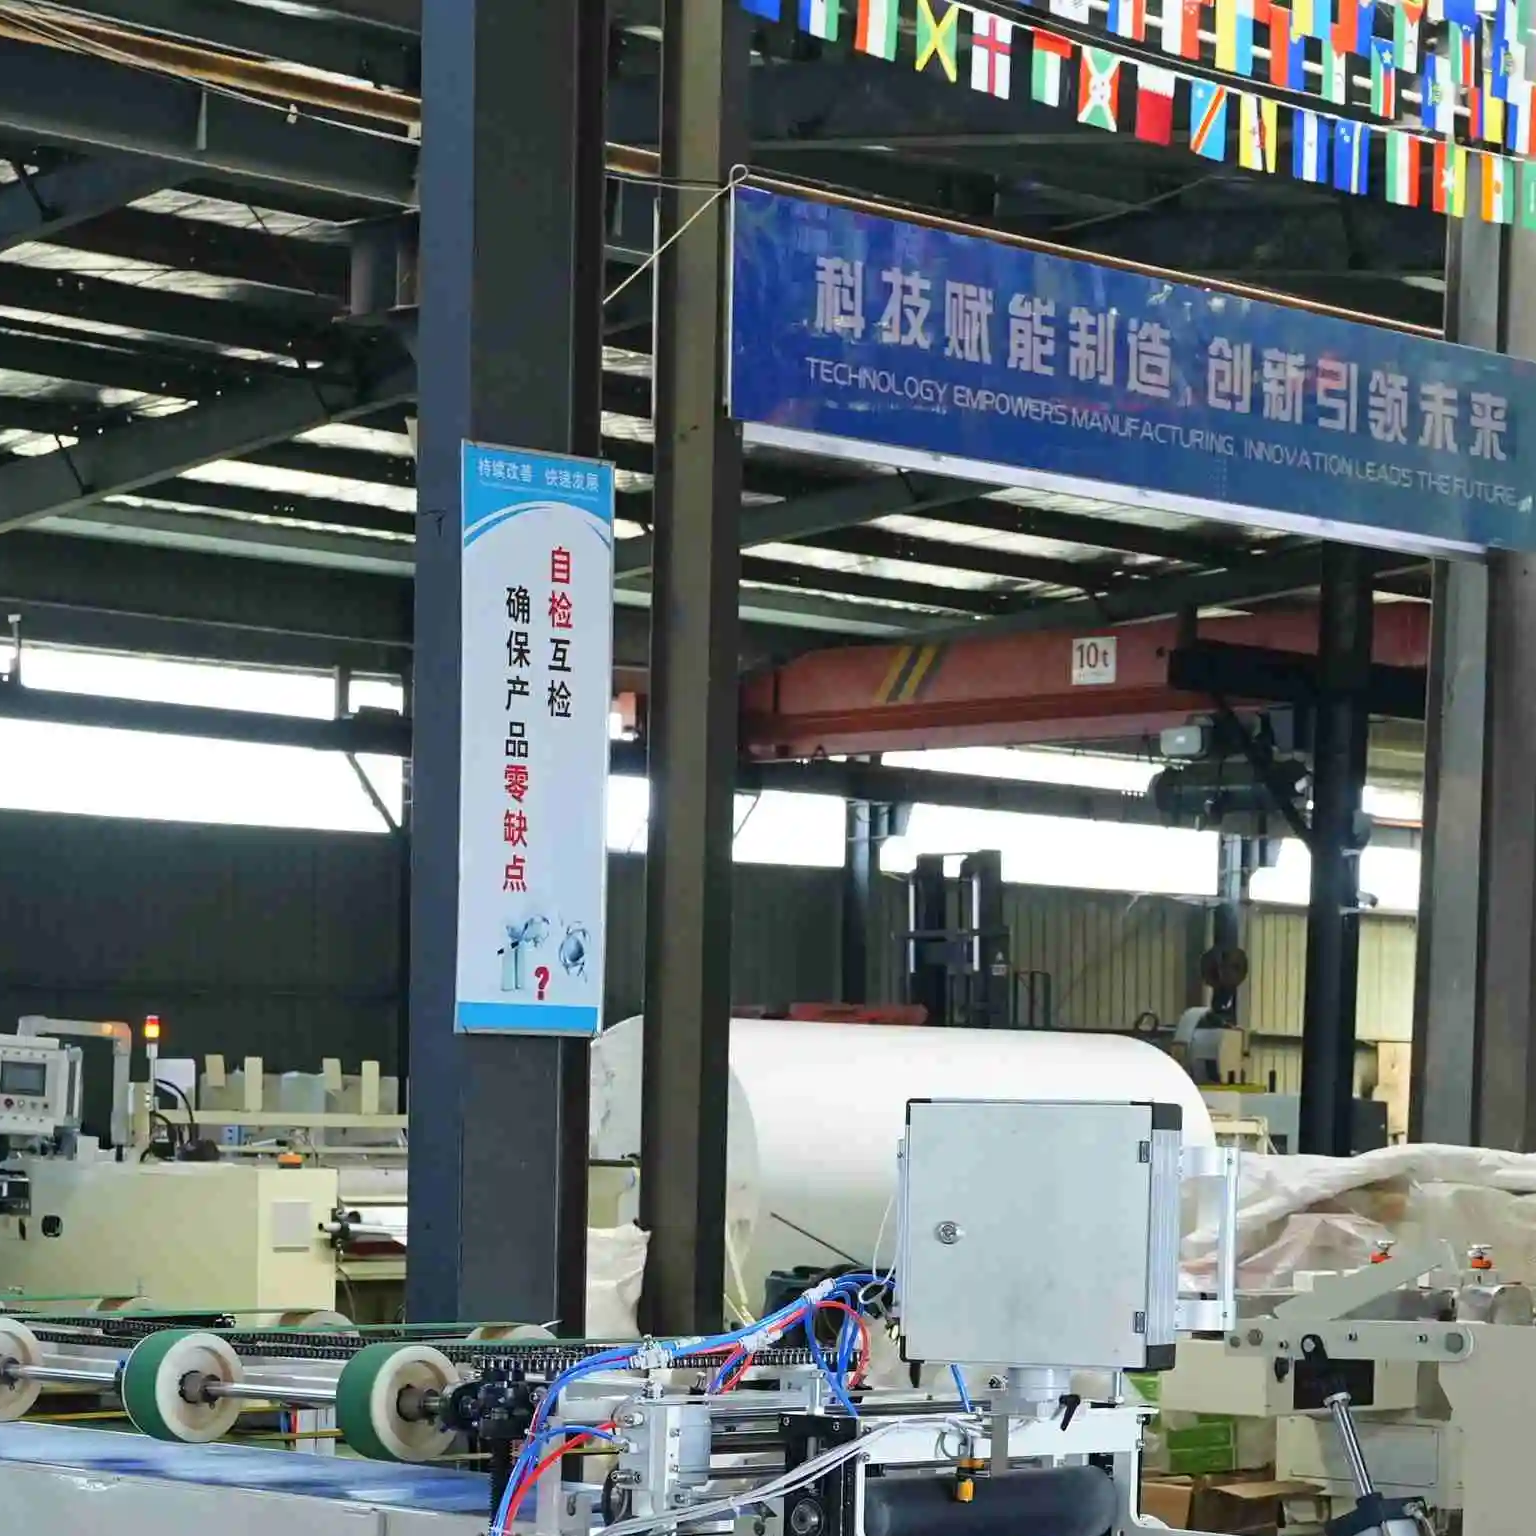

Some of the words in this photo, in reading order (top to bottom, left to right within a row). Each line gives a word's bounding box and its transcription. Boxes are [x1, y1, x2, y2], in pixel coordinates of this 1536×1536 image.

[804, 356, 950, 403] TECHNOLOGY
[953, 385, 1068, 426] EMPOWERS
[1243, 440, 1353, 479] INNOVATION
[1355, 461, 1413, 489] LEADS
[547, 546, 573, 719] 自检互检
[502, 584, 531, 893] 确保产品零缺点
